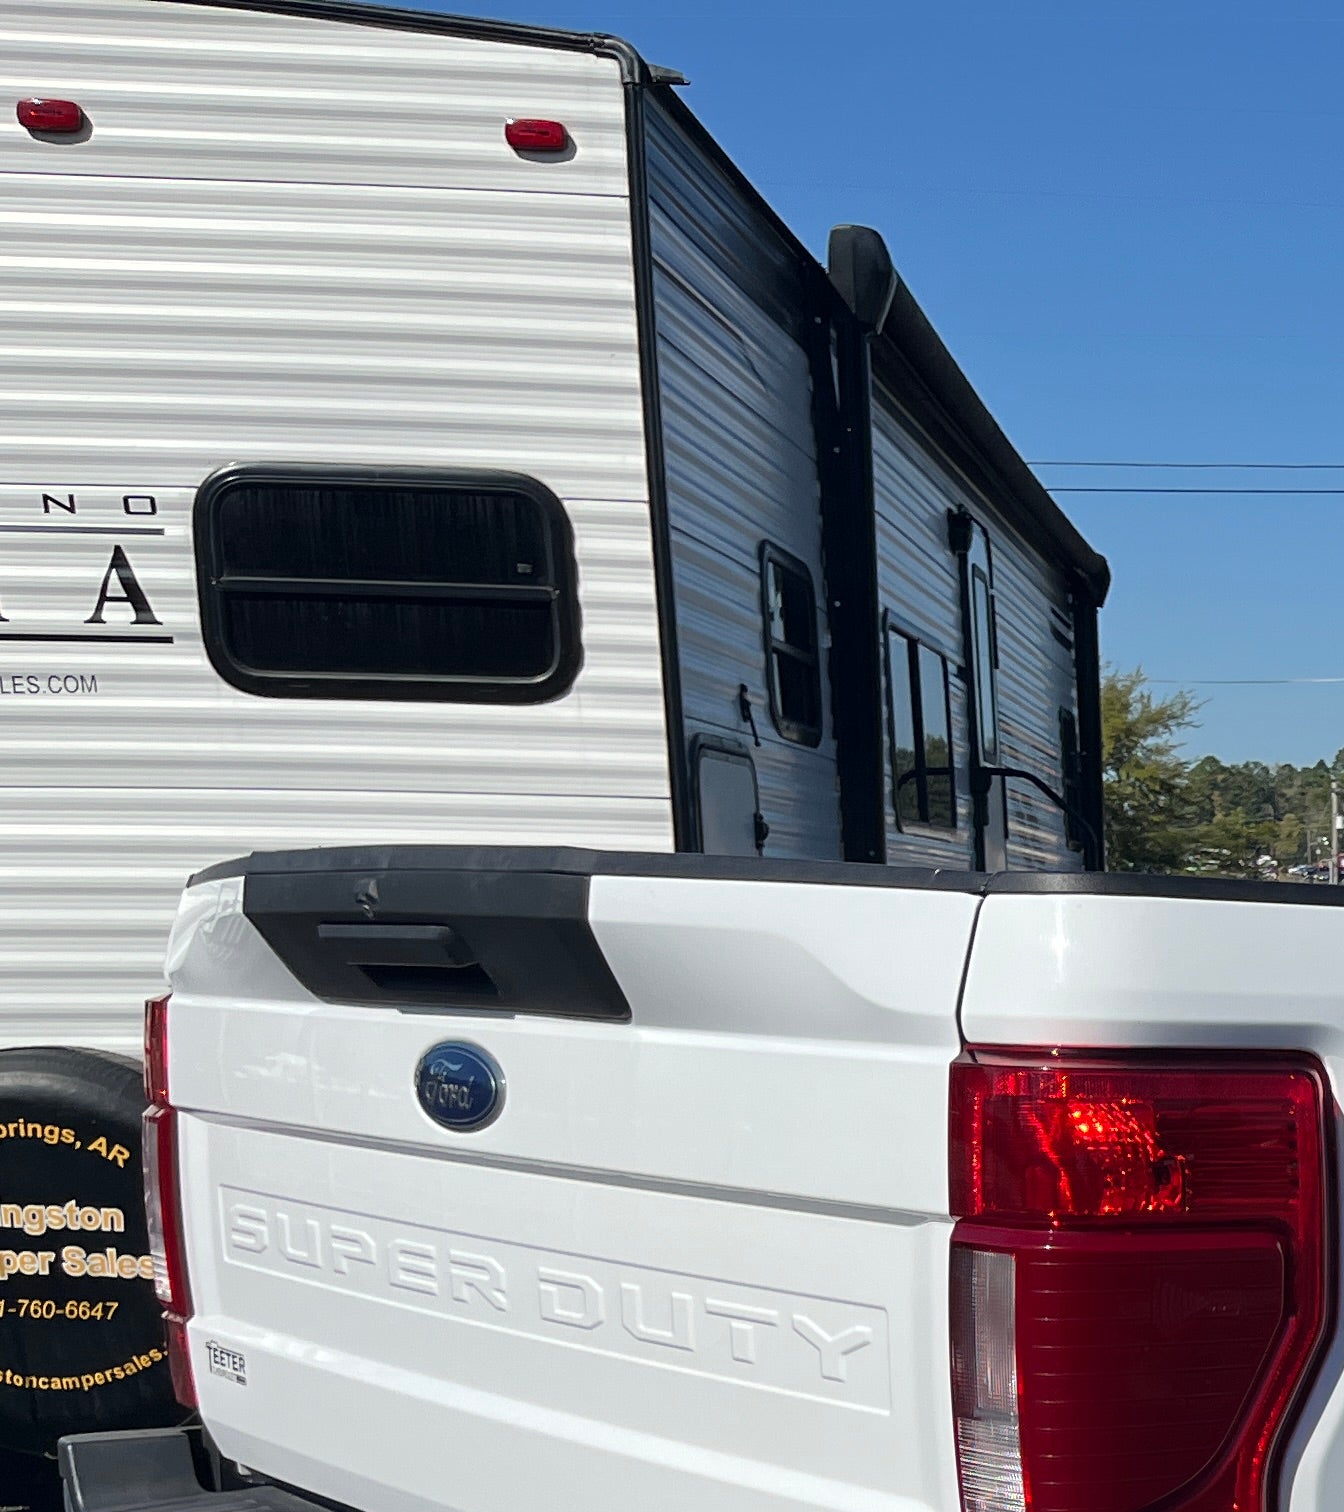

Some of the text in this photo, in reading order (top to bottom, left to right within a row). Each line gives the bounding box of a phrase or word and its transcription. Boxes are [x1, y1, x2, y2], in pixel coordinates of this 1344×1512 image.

[87, 1136, 130, 1169] AR
[0, 1199, 125, 1236] ngston
[62, 1245, 155, 1280] Sales
[228, 1202, 874, 1384] SUPER DUTY
[206, 1341, 246, 1375] TEETER
